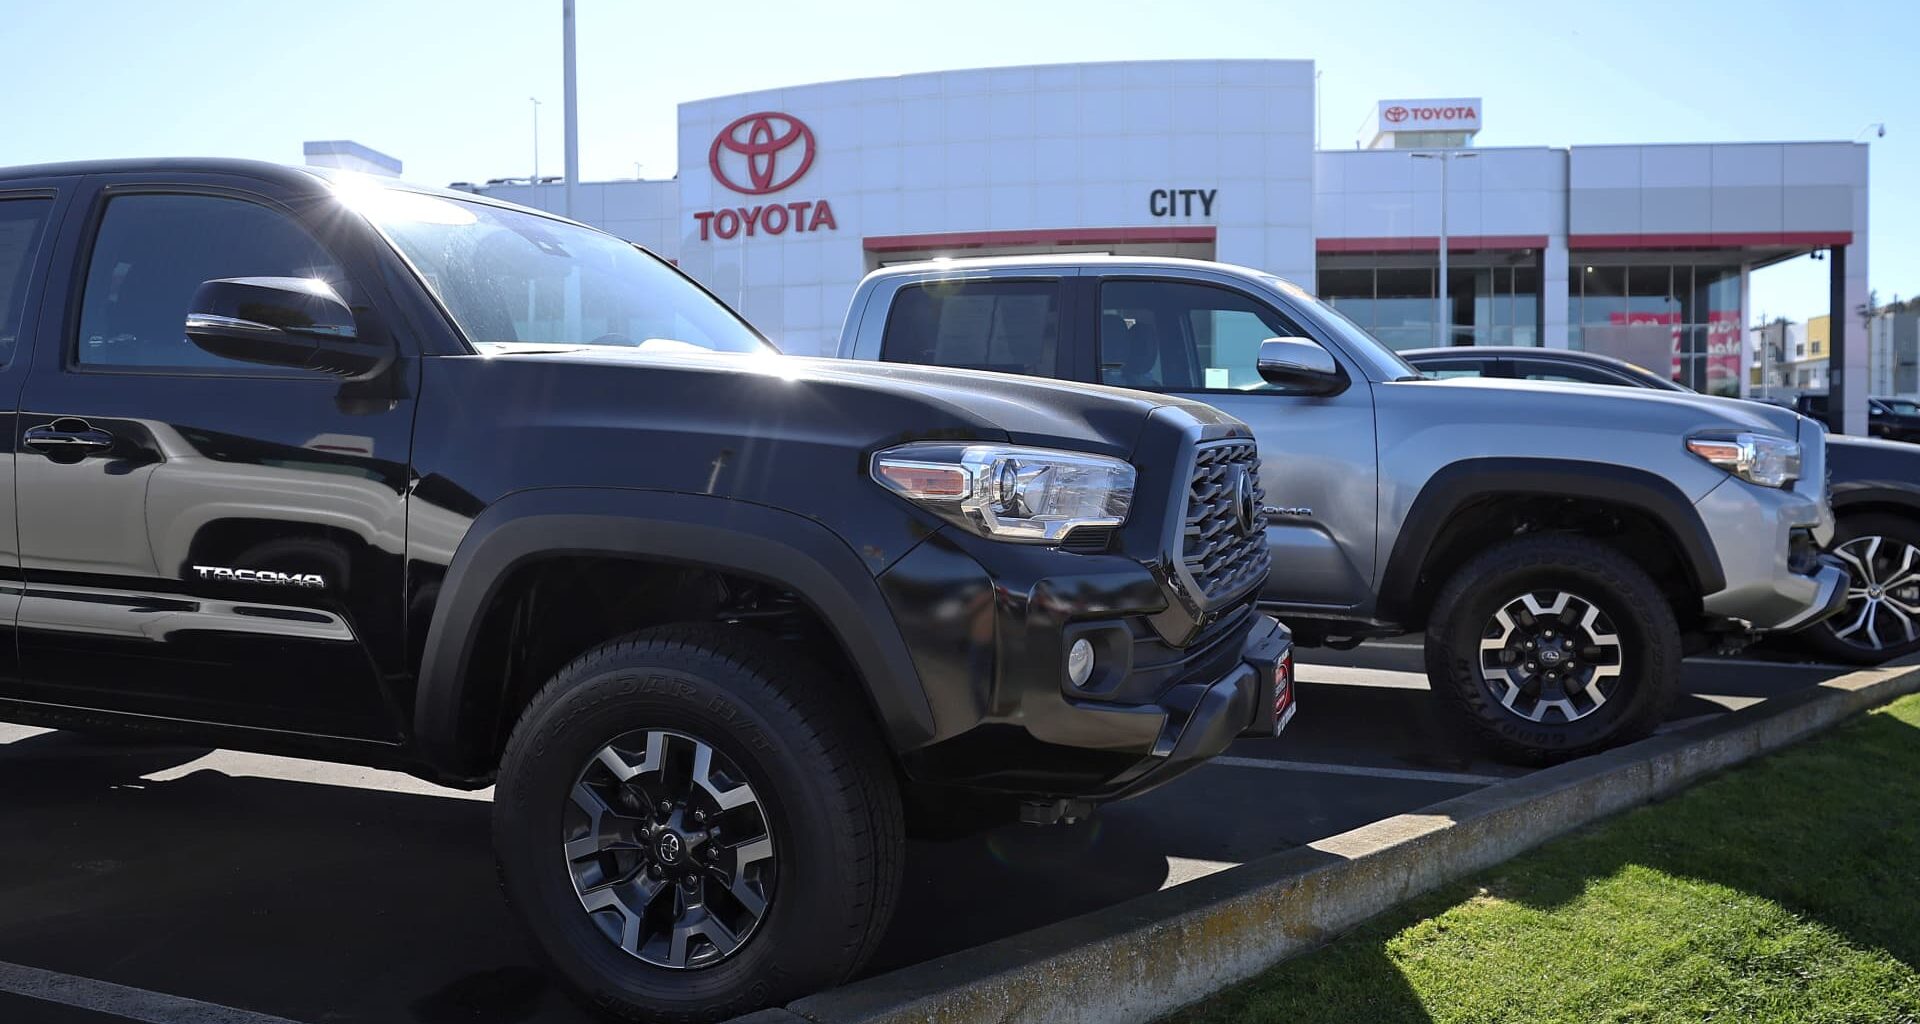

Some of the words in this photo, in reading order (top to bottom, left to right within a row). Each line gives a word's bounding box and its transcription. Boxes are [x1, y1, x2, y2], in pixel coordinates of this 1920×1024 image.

[1411, 107, 1475, 120] TOYOTA
[1150, 189, 1217, 217] CITY
[694, 200, 836, 240] TOYOTA
[1262, 506, 1312, 516] OMA
[193, 565, 325, 588] TACOMA
